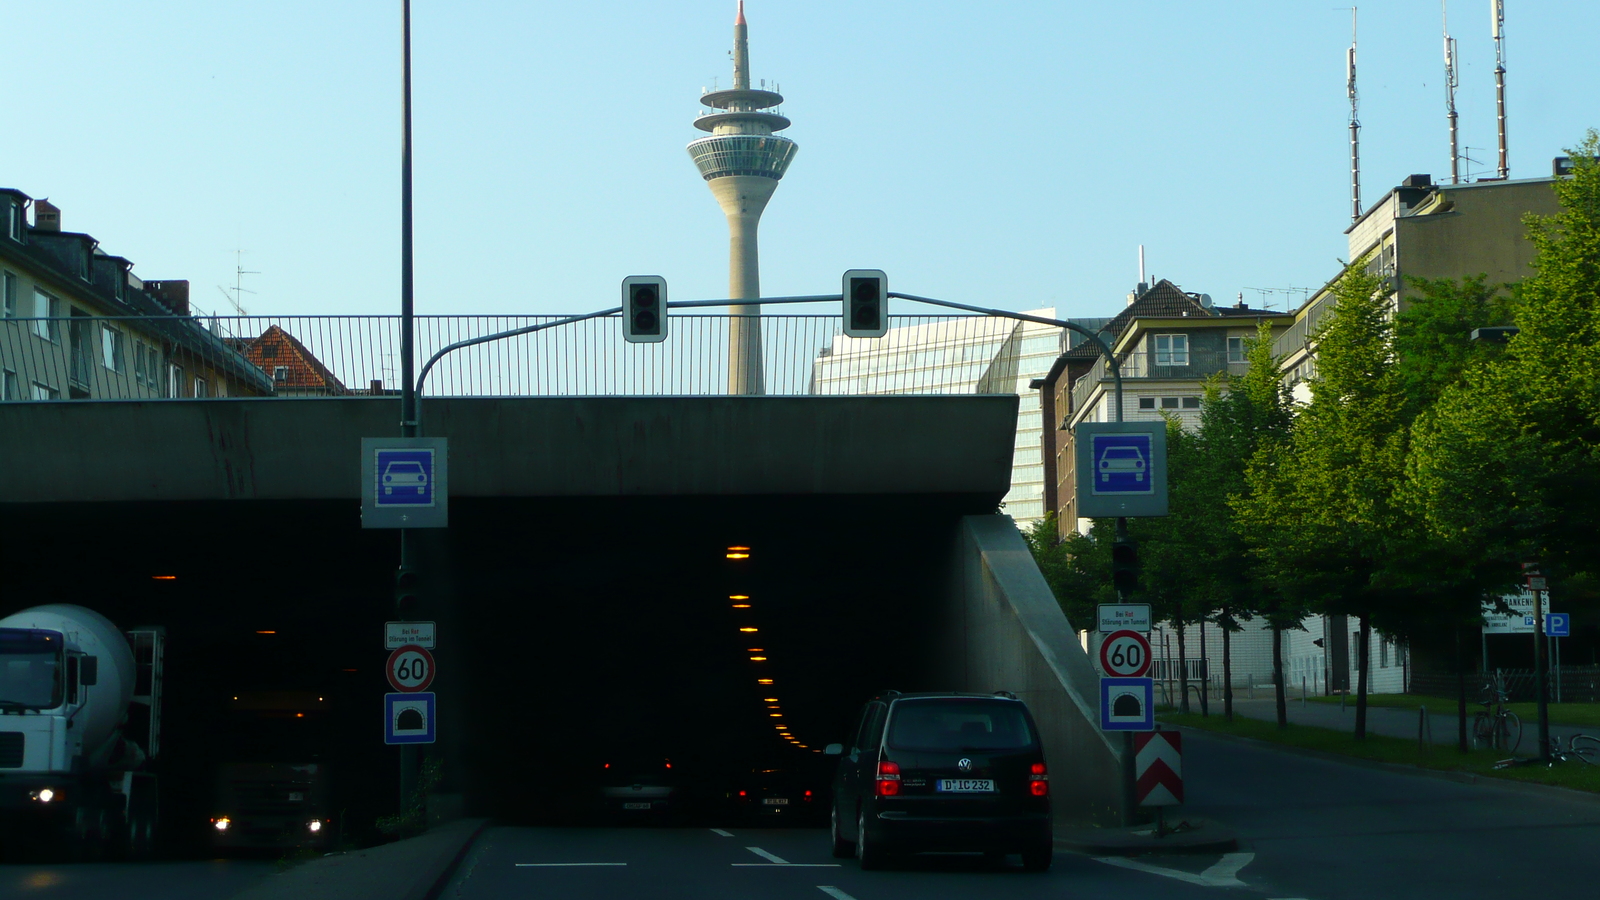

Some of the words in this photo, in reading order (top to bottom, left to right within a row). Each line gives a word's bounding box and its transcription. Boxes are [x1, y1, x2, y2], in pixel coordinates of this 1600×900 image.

[1102, 618, 1121, 626] Störung
[1551, 616, 1564, 634] P
[1112, 644, 1140, 668] 60
[398, 658, 424, 680] 60
[972, 781, 990, 790] 232
